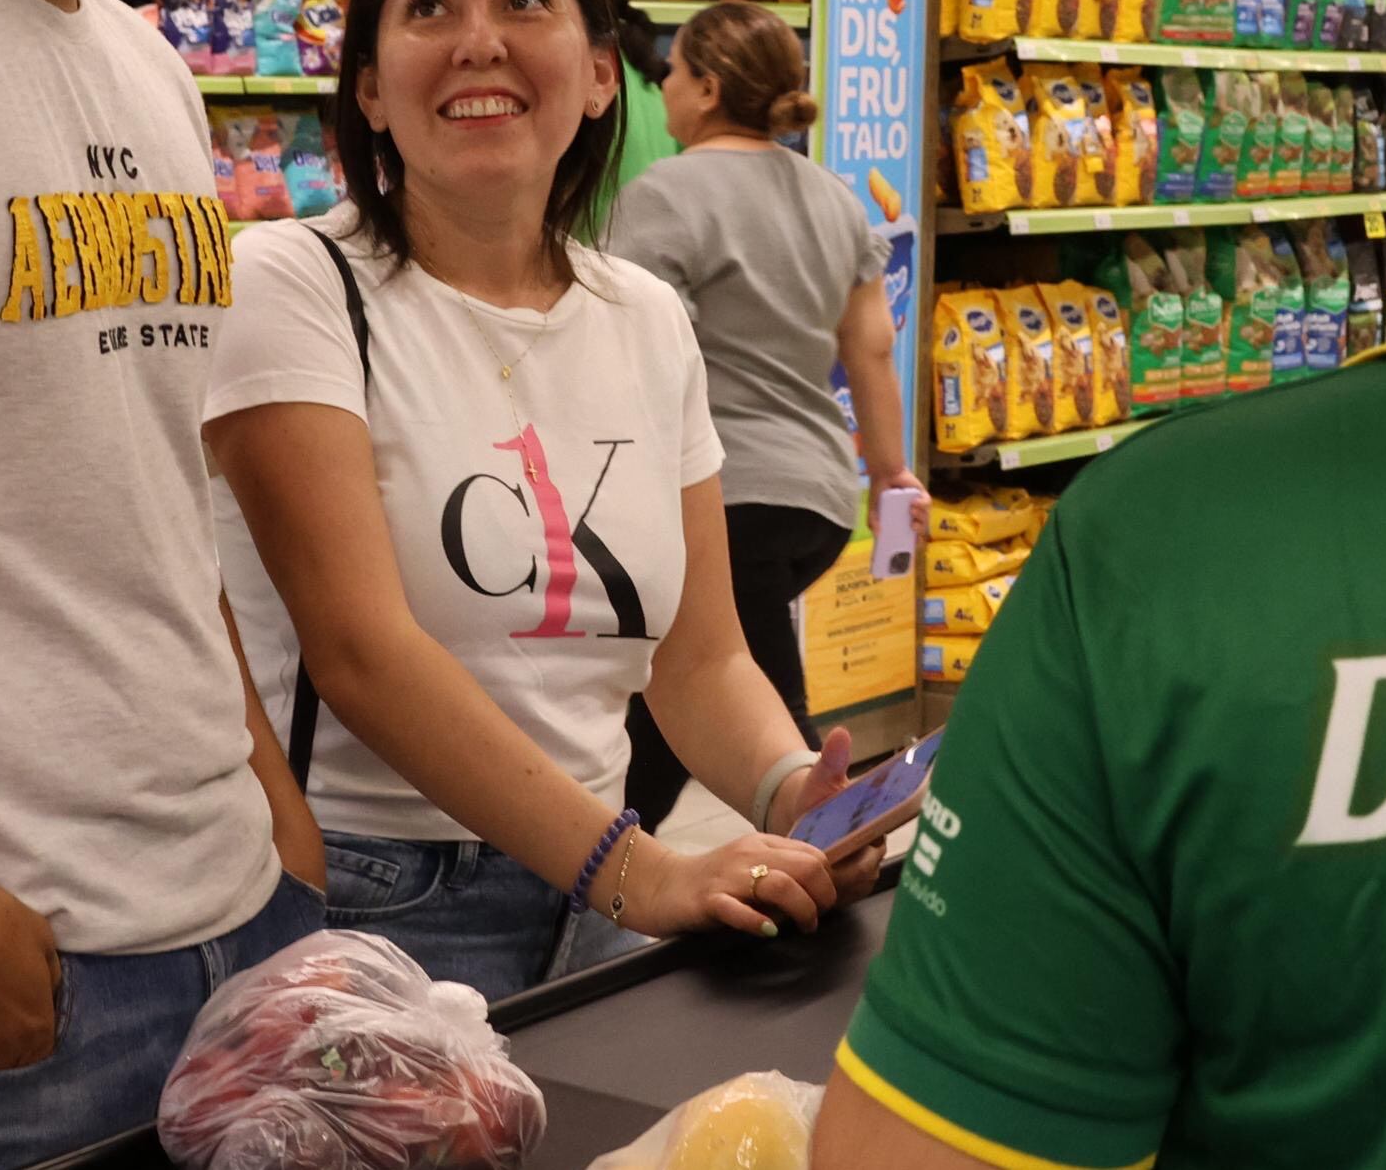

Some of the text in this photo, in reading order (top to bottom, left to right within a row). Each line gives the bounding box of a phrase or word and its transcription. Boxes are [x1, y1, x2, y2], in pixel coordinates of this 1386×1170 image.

[837, 121, 908, 161] TALO
[86, 144, 138, 180] NYC
[140, 323, 210, 349] STATE
